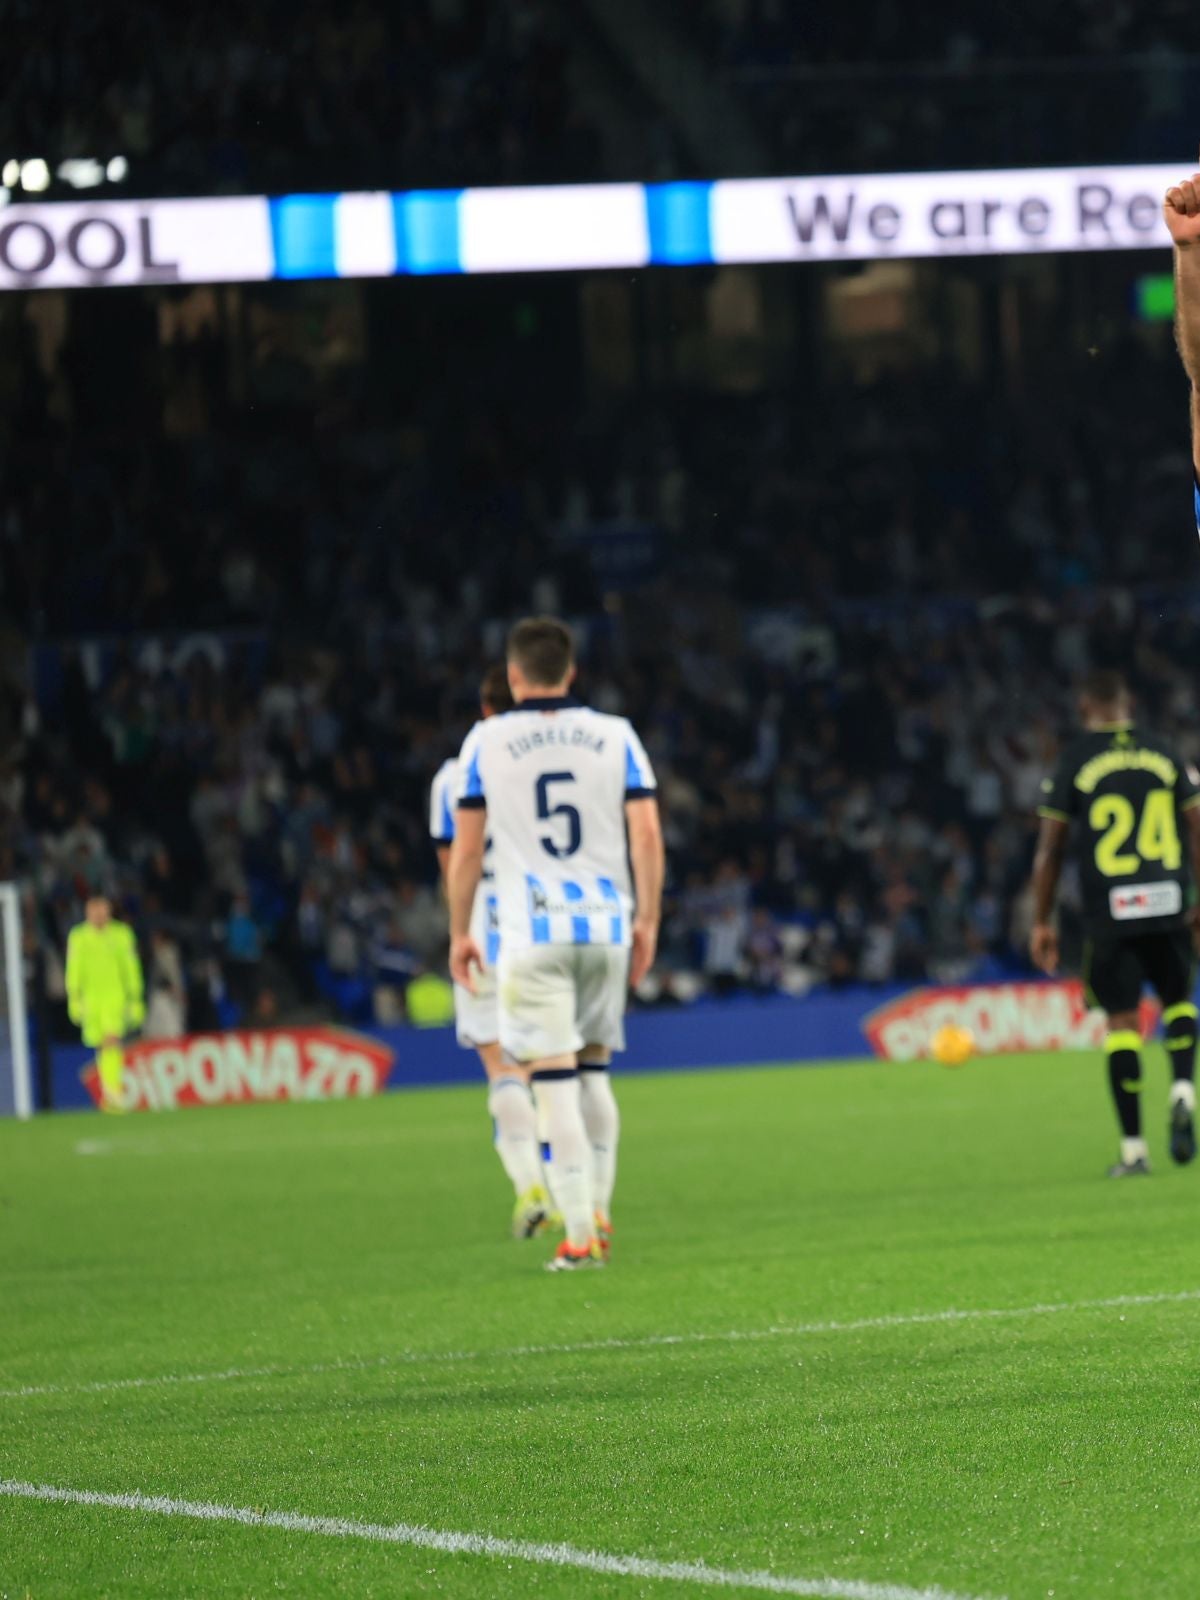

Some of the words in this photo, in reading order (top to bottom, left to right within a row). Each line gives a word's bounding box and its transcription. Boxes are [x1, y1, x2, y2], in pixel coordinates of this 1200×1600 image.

[788, 194, 902, 244] We
[928, 190, 1051, 239] are
[535, 771, 581, 859] 5
[1088, 788, 1182, 879] 24
